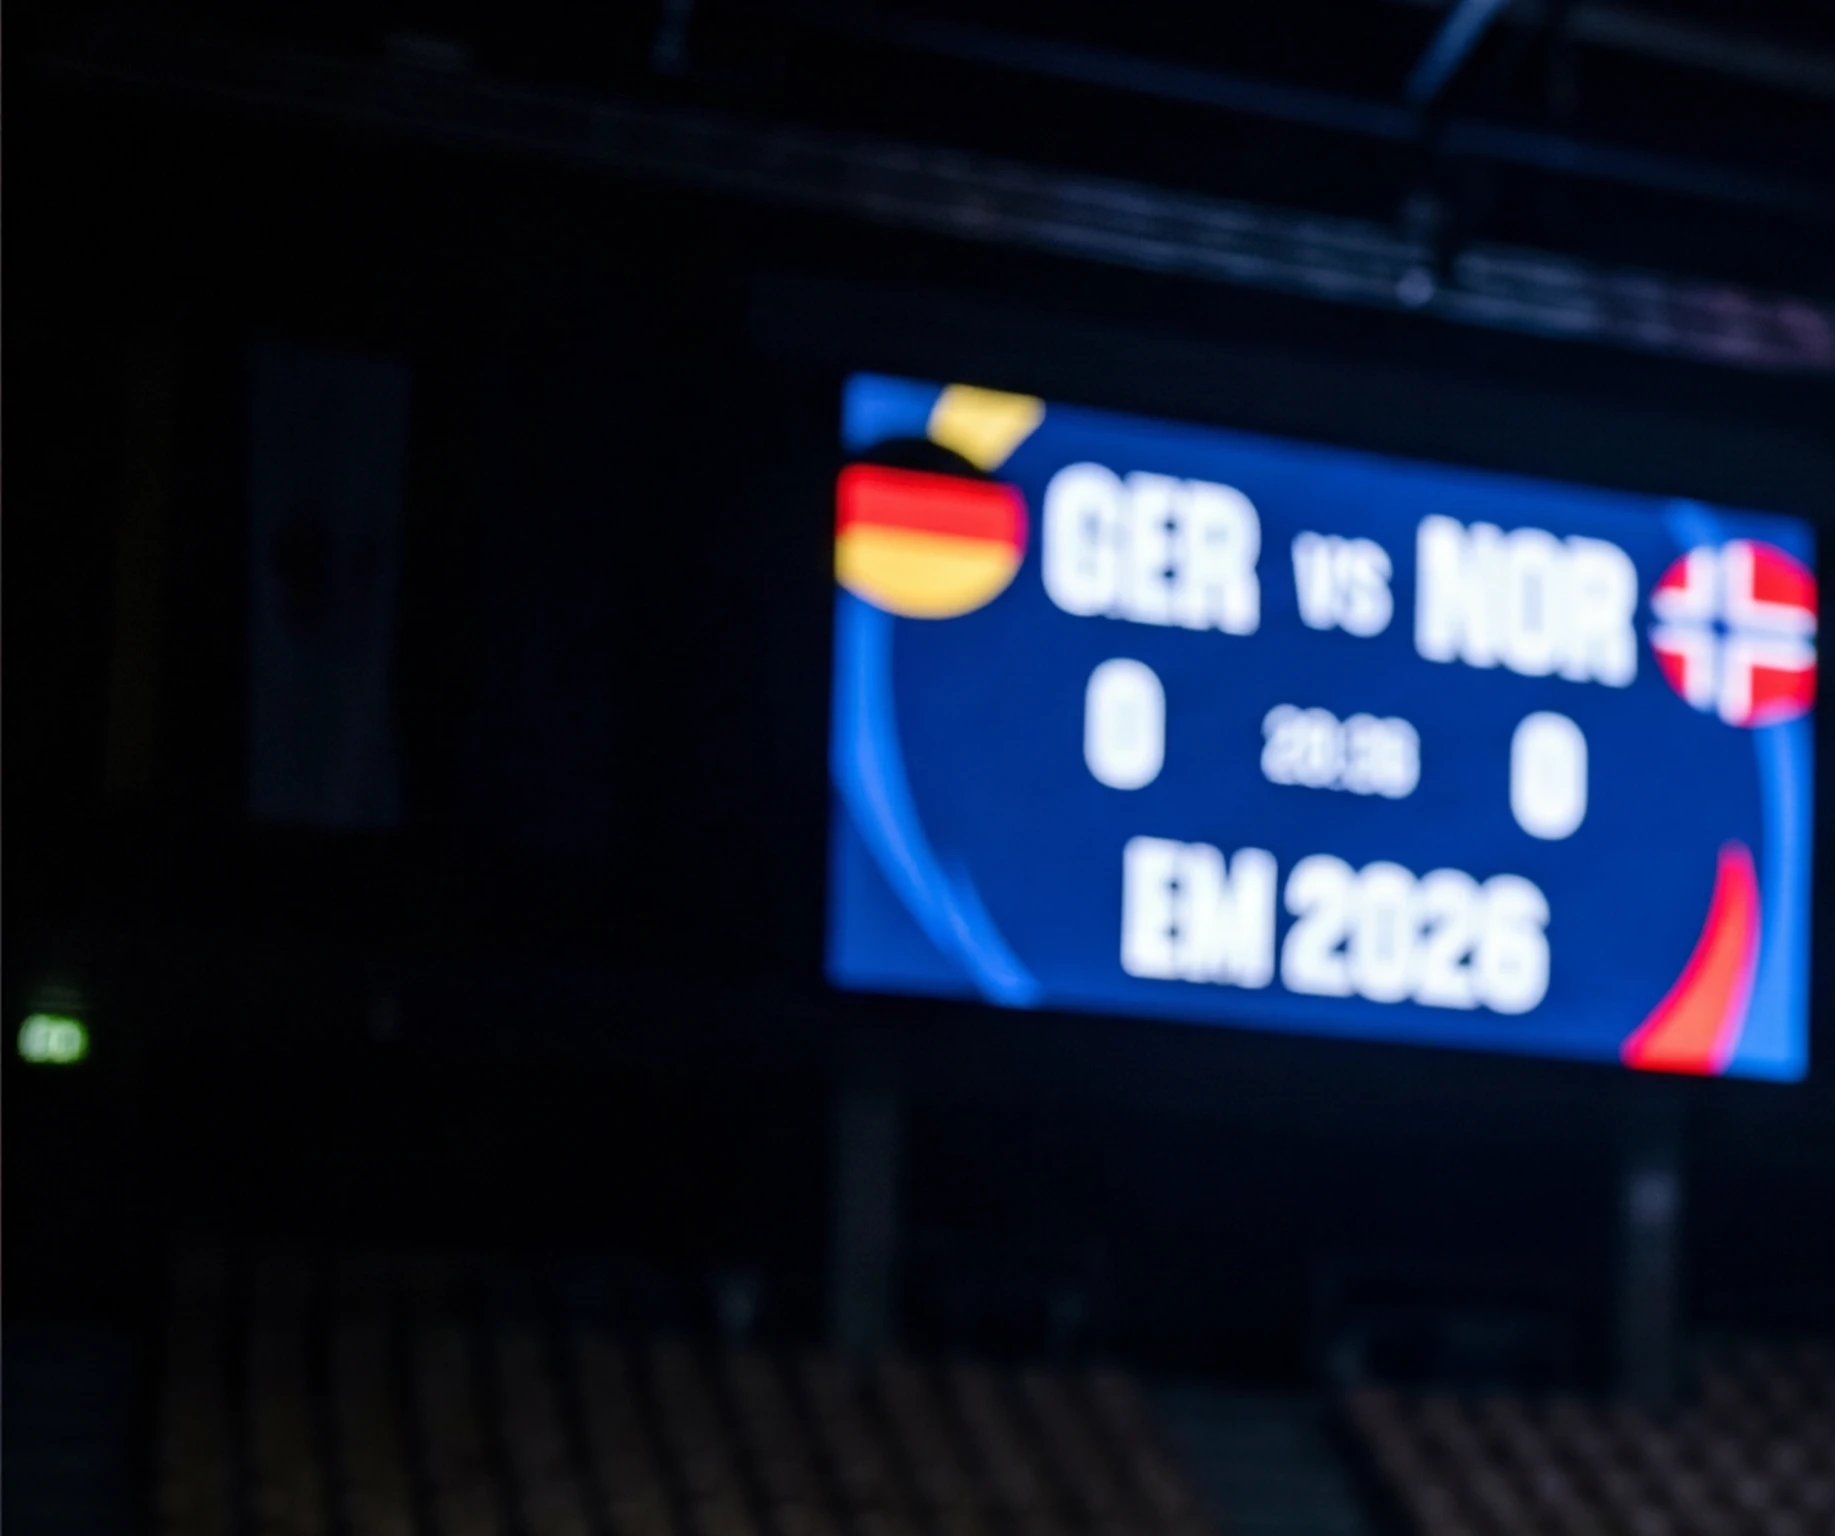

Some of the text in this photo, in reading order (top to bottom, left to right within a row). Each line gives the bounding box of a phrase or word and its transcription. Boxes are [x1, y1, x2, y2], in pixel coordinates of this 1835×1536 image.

[1043, 463, 1260, 635] GER
[1415, 515, 1638, 686] NOR
[1084, 659, 1165, 789] 0
[1510, 713, 1587, 839] 0
[1121, 836, 1550, 1013] EM 2026
